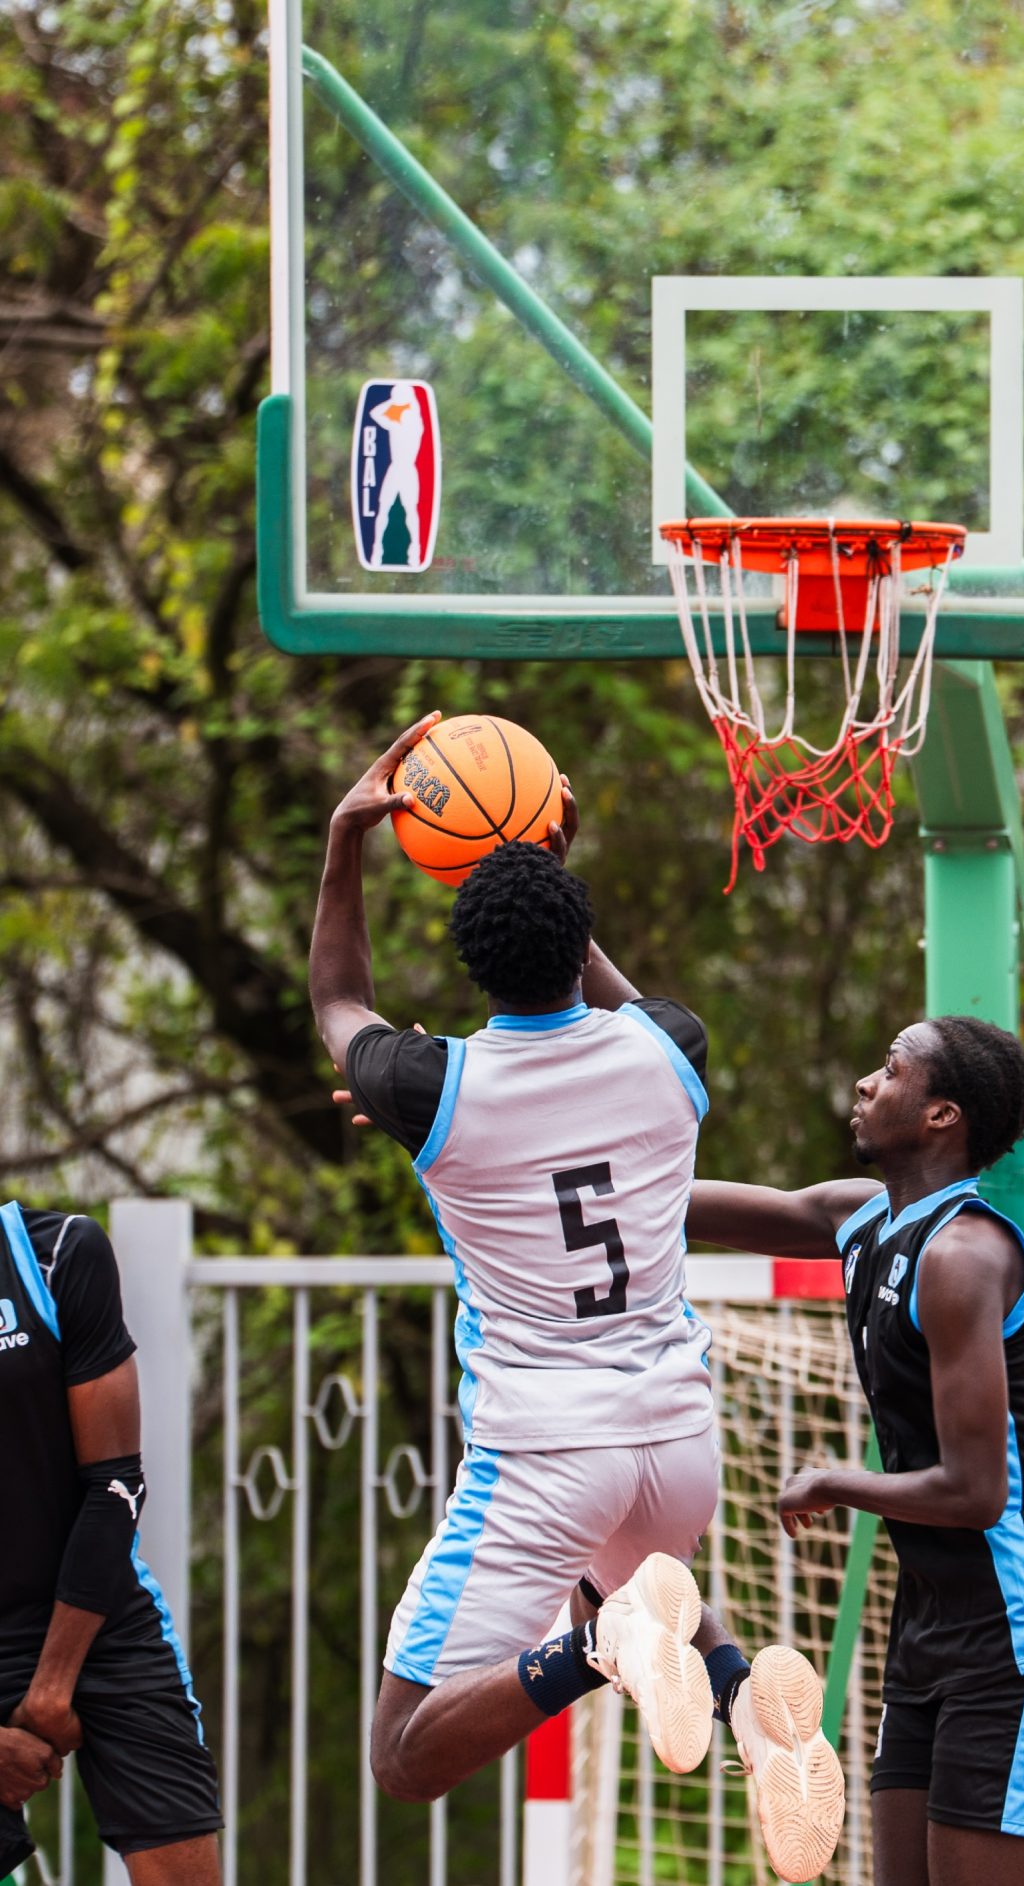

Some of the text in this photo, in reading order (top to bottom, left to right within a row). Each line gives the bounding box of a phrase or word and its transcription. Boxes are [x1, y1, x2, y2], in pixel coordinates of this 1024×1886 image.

[363, 426, 376, 517] BAL
[551, 1161, 630, 1319] 5
[0, 1332, 30, 1351] ave
